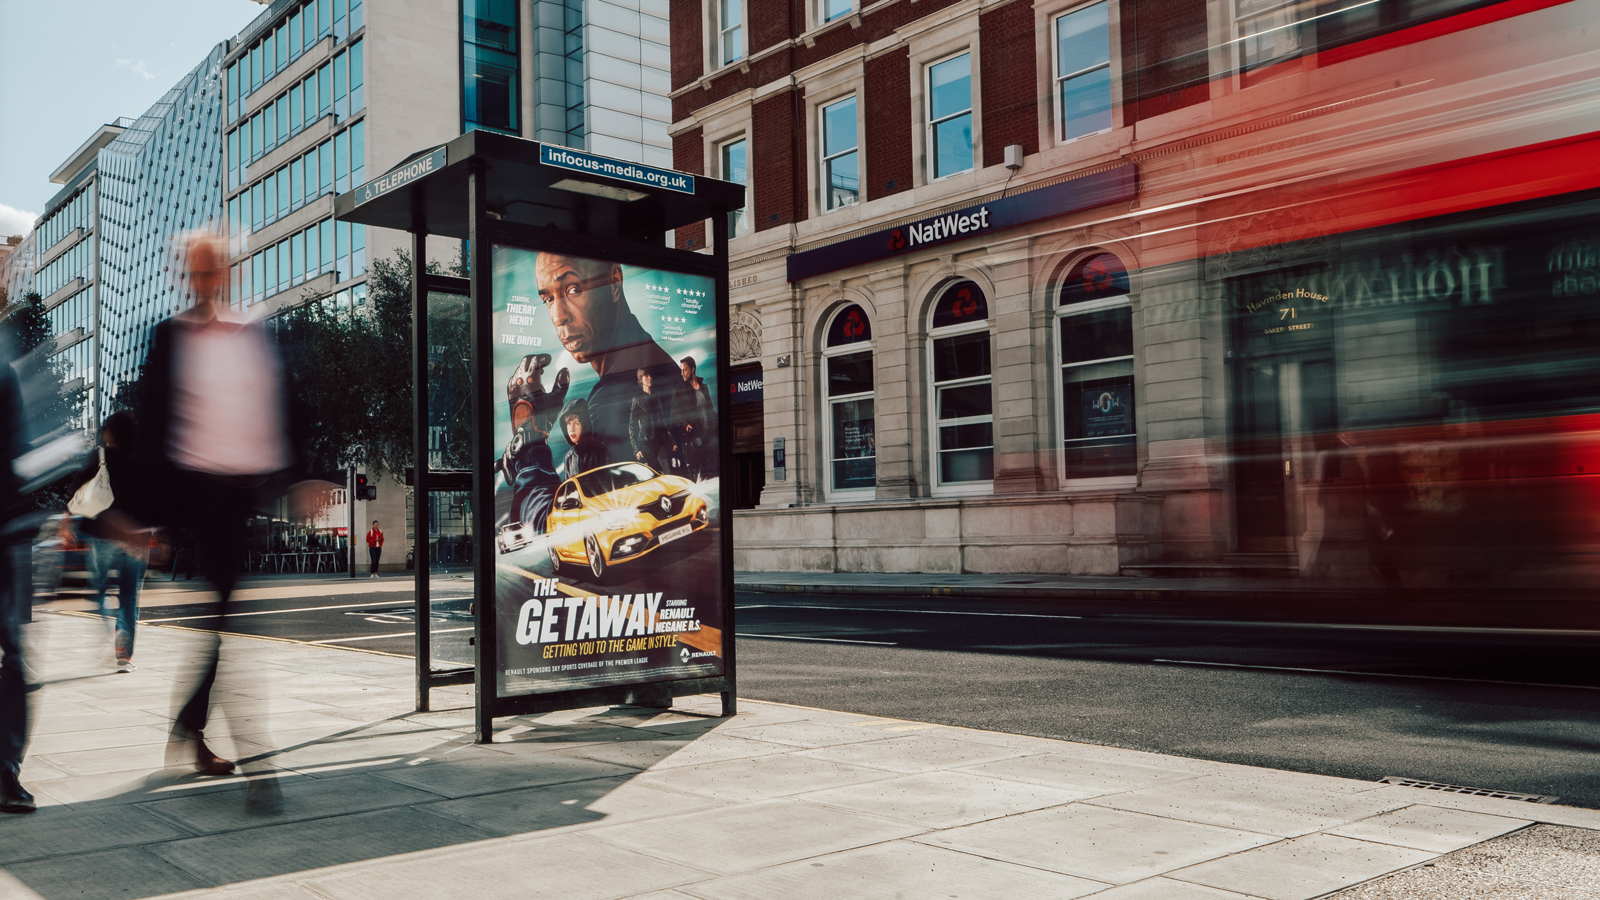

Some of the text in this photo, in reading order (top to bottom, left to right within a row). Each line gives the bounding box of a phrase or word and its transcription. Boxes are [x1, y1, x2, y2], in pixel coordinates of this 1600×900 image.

[548, 148, 687, 188] infocus-media.org.uk
[373, 157, 433, 195] TELEPHONE
[909, 206, 989, 246] NatWest
[511, 295, 531, 304] STARRING
[1246, 288, 1328, 313] Havinden House
[506, 303, 537, 316] THIERRY
[1279, 307, 1295, 320] 71
[509, 315, 534, 327] HENRY
[1263, 323, 1313, 335] BAKER STREET
[502, 334, 542, 347] THE DRIVER
[737, 379, 763, 393] NatWe
[661, 530, 682, 541] MEGANE
[533, 577, 559, 597] THE
[666, 599, 687, 607] STARRING
[515, 592, 663, 645] GETAWAY
[660, 607, 695, 620] RENAULT
[655, 620, 688, 633] MEGANE
[543, 634, 678, 659] GETTING YOU TO THE GAME IN STYLE
[505, 667, 526, 676] RENAULT
[527, 665, 551, 675] SPONSORS
[561, 663, 577, 671] SPORTS
[578, 661, 598, 669] COVERAGE
[615, 657, 633, 666] PREMIER
[634, 657, 648, 665] LEAGUE
